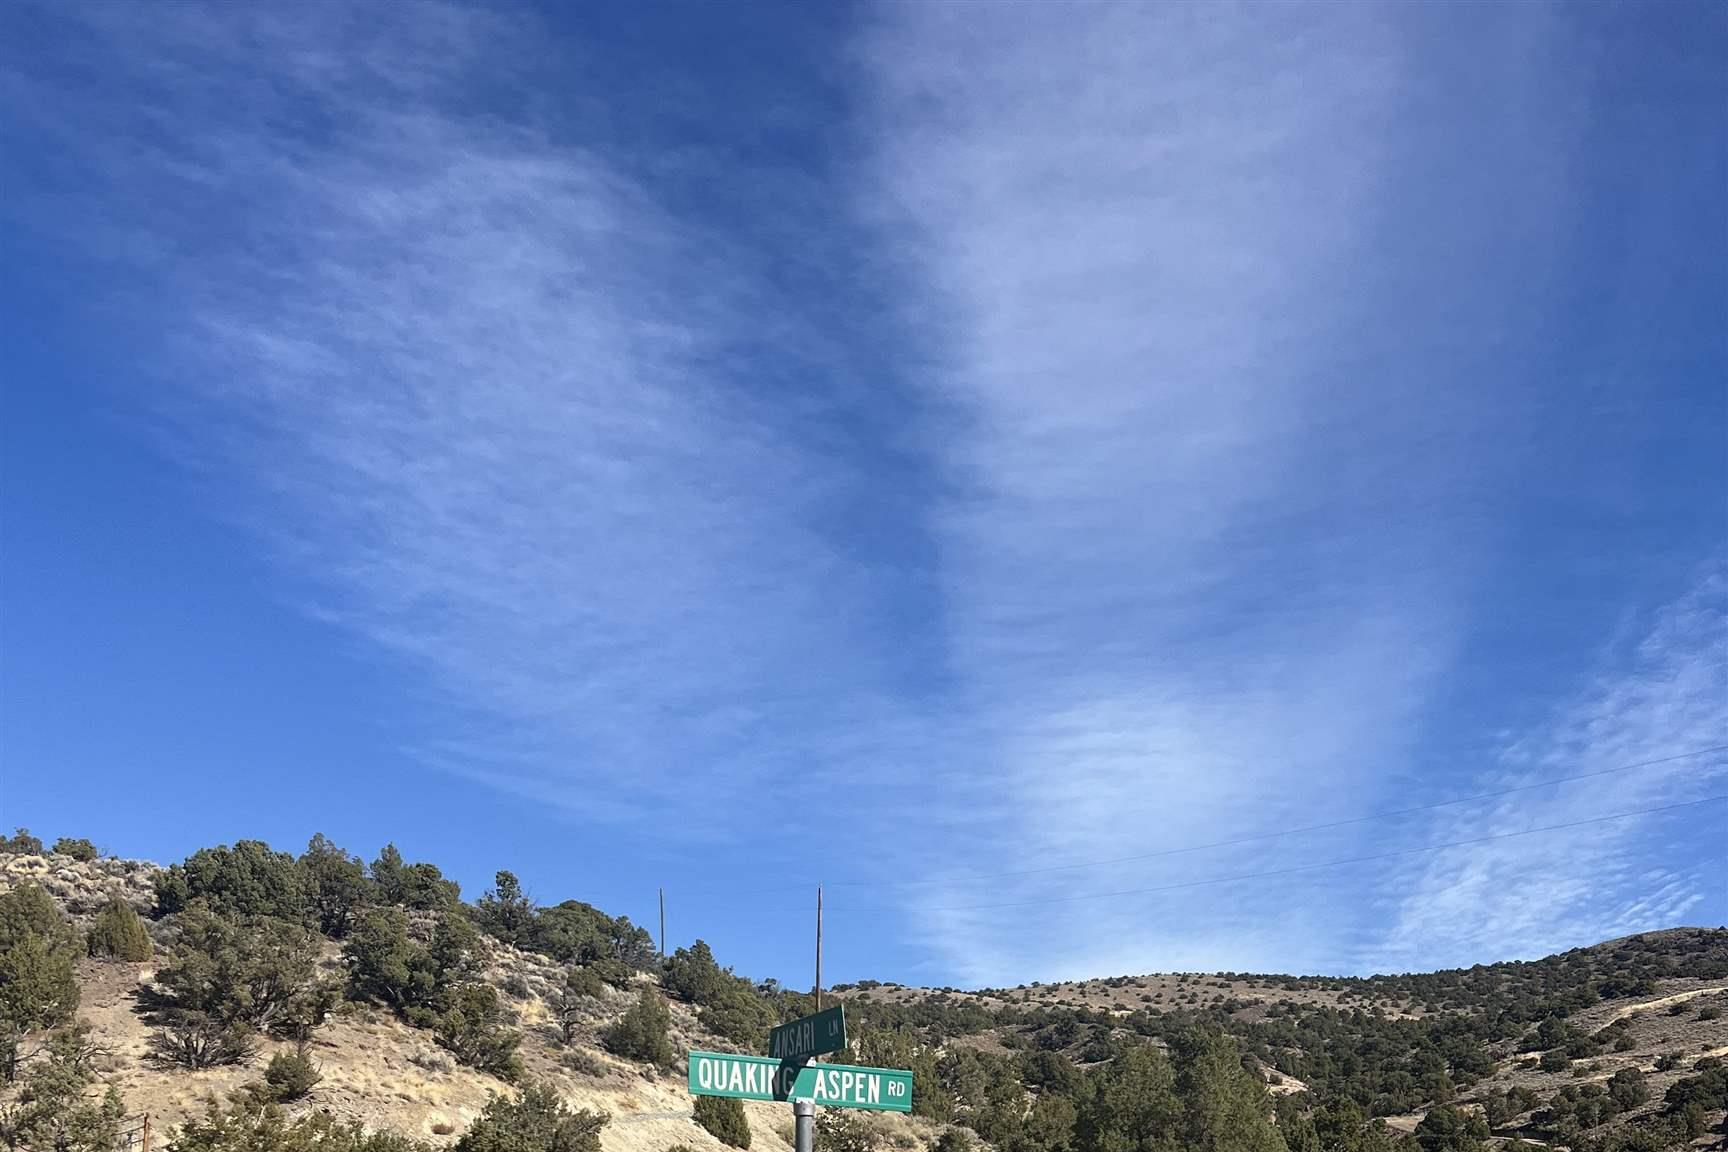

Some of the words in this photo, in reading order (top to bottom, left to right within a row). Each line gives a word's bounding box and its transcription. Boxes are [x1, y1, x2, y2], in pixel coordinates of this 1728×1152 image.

[773, 1021, 815, 1058] ANSARI
[828, 1018, 839, 1037] LN
[699, 1058, 795, 1096] QUAKING
[813, 1069, 881, 1104] ASPEN
[887, 1080, 905, 1097] RD
